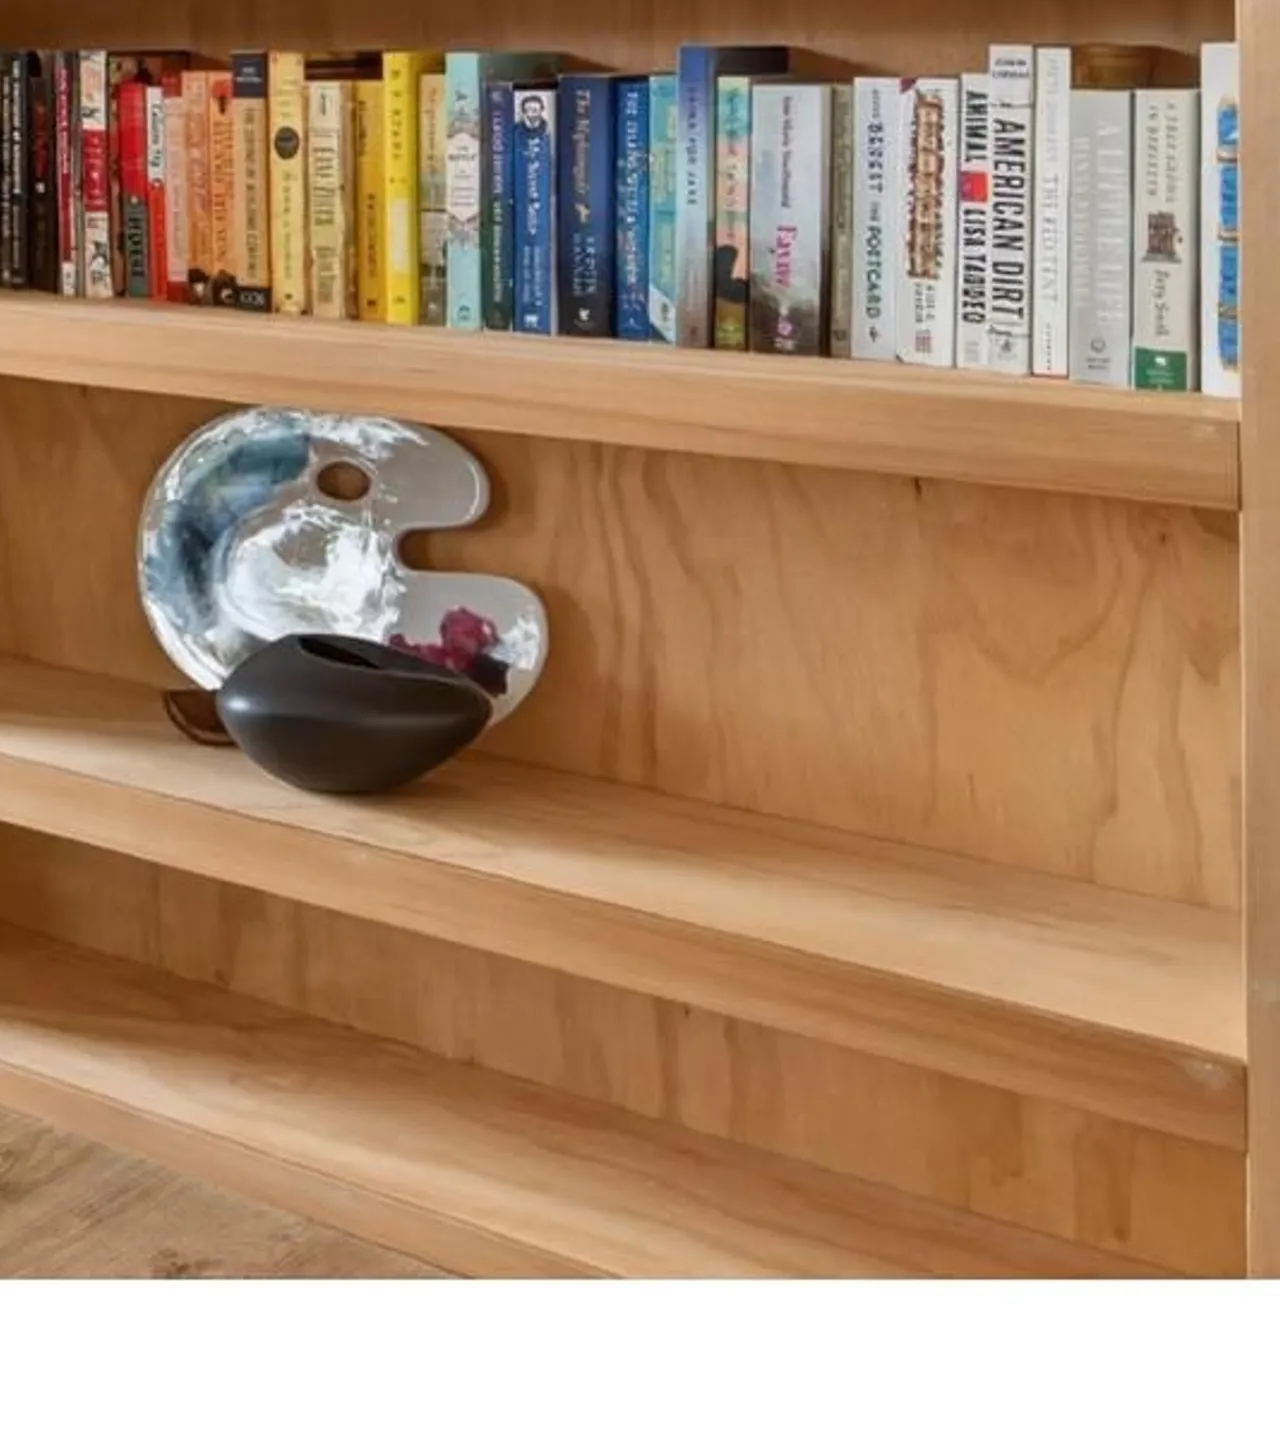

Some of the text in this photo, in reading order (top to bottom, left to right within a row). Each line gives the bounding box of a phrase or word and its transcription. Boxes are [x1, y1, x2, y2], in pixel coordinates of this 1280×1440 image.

[965, 90, 989, 163] ANIMAL
[962, 208, 987, 248] LISA
[991, 117, 1027, 320] AMERICAN DIRT
[866, 225, 883, 320] POSTCARD
